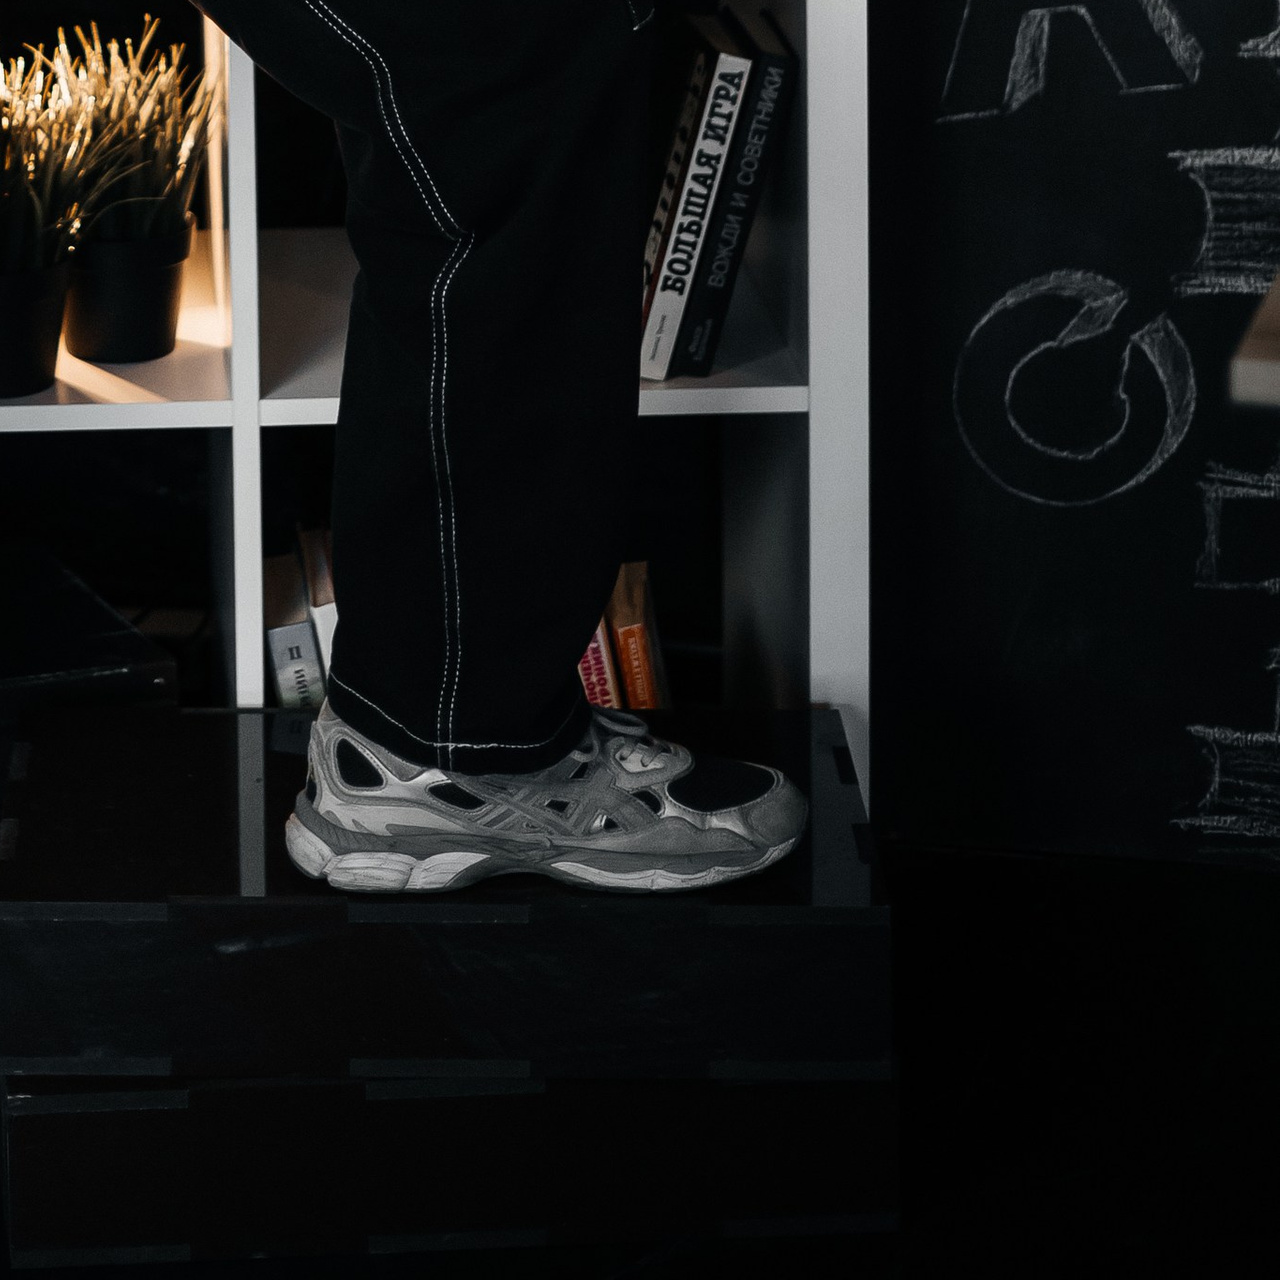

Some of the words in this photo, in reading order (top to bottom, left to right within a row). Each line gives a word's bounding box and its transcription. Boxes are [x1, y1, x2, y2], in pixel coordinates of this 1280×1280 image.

[661, 148, 721, 295] БОЛЬШАЯ
[704, 70, 744, 147] ИГРА
[737, 66, 784, 185] СОВЕТНИКИ
